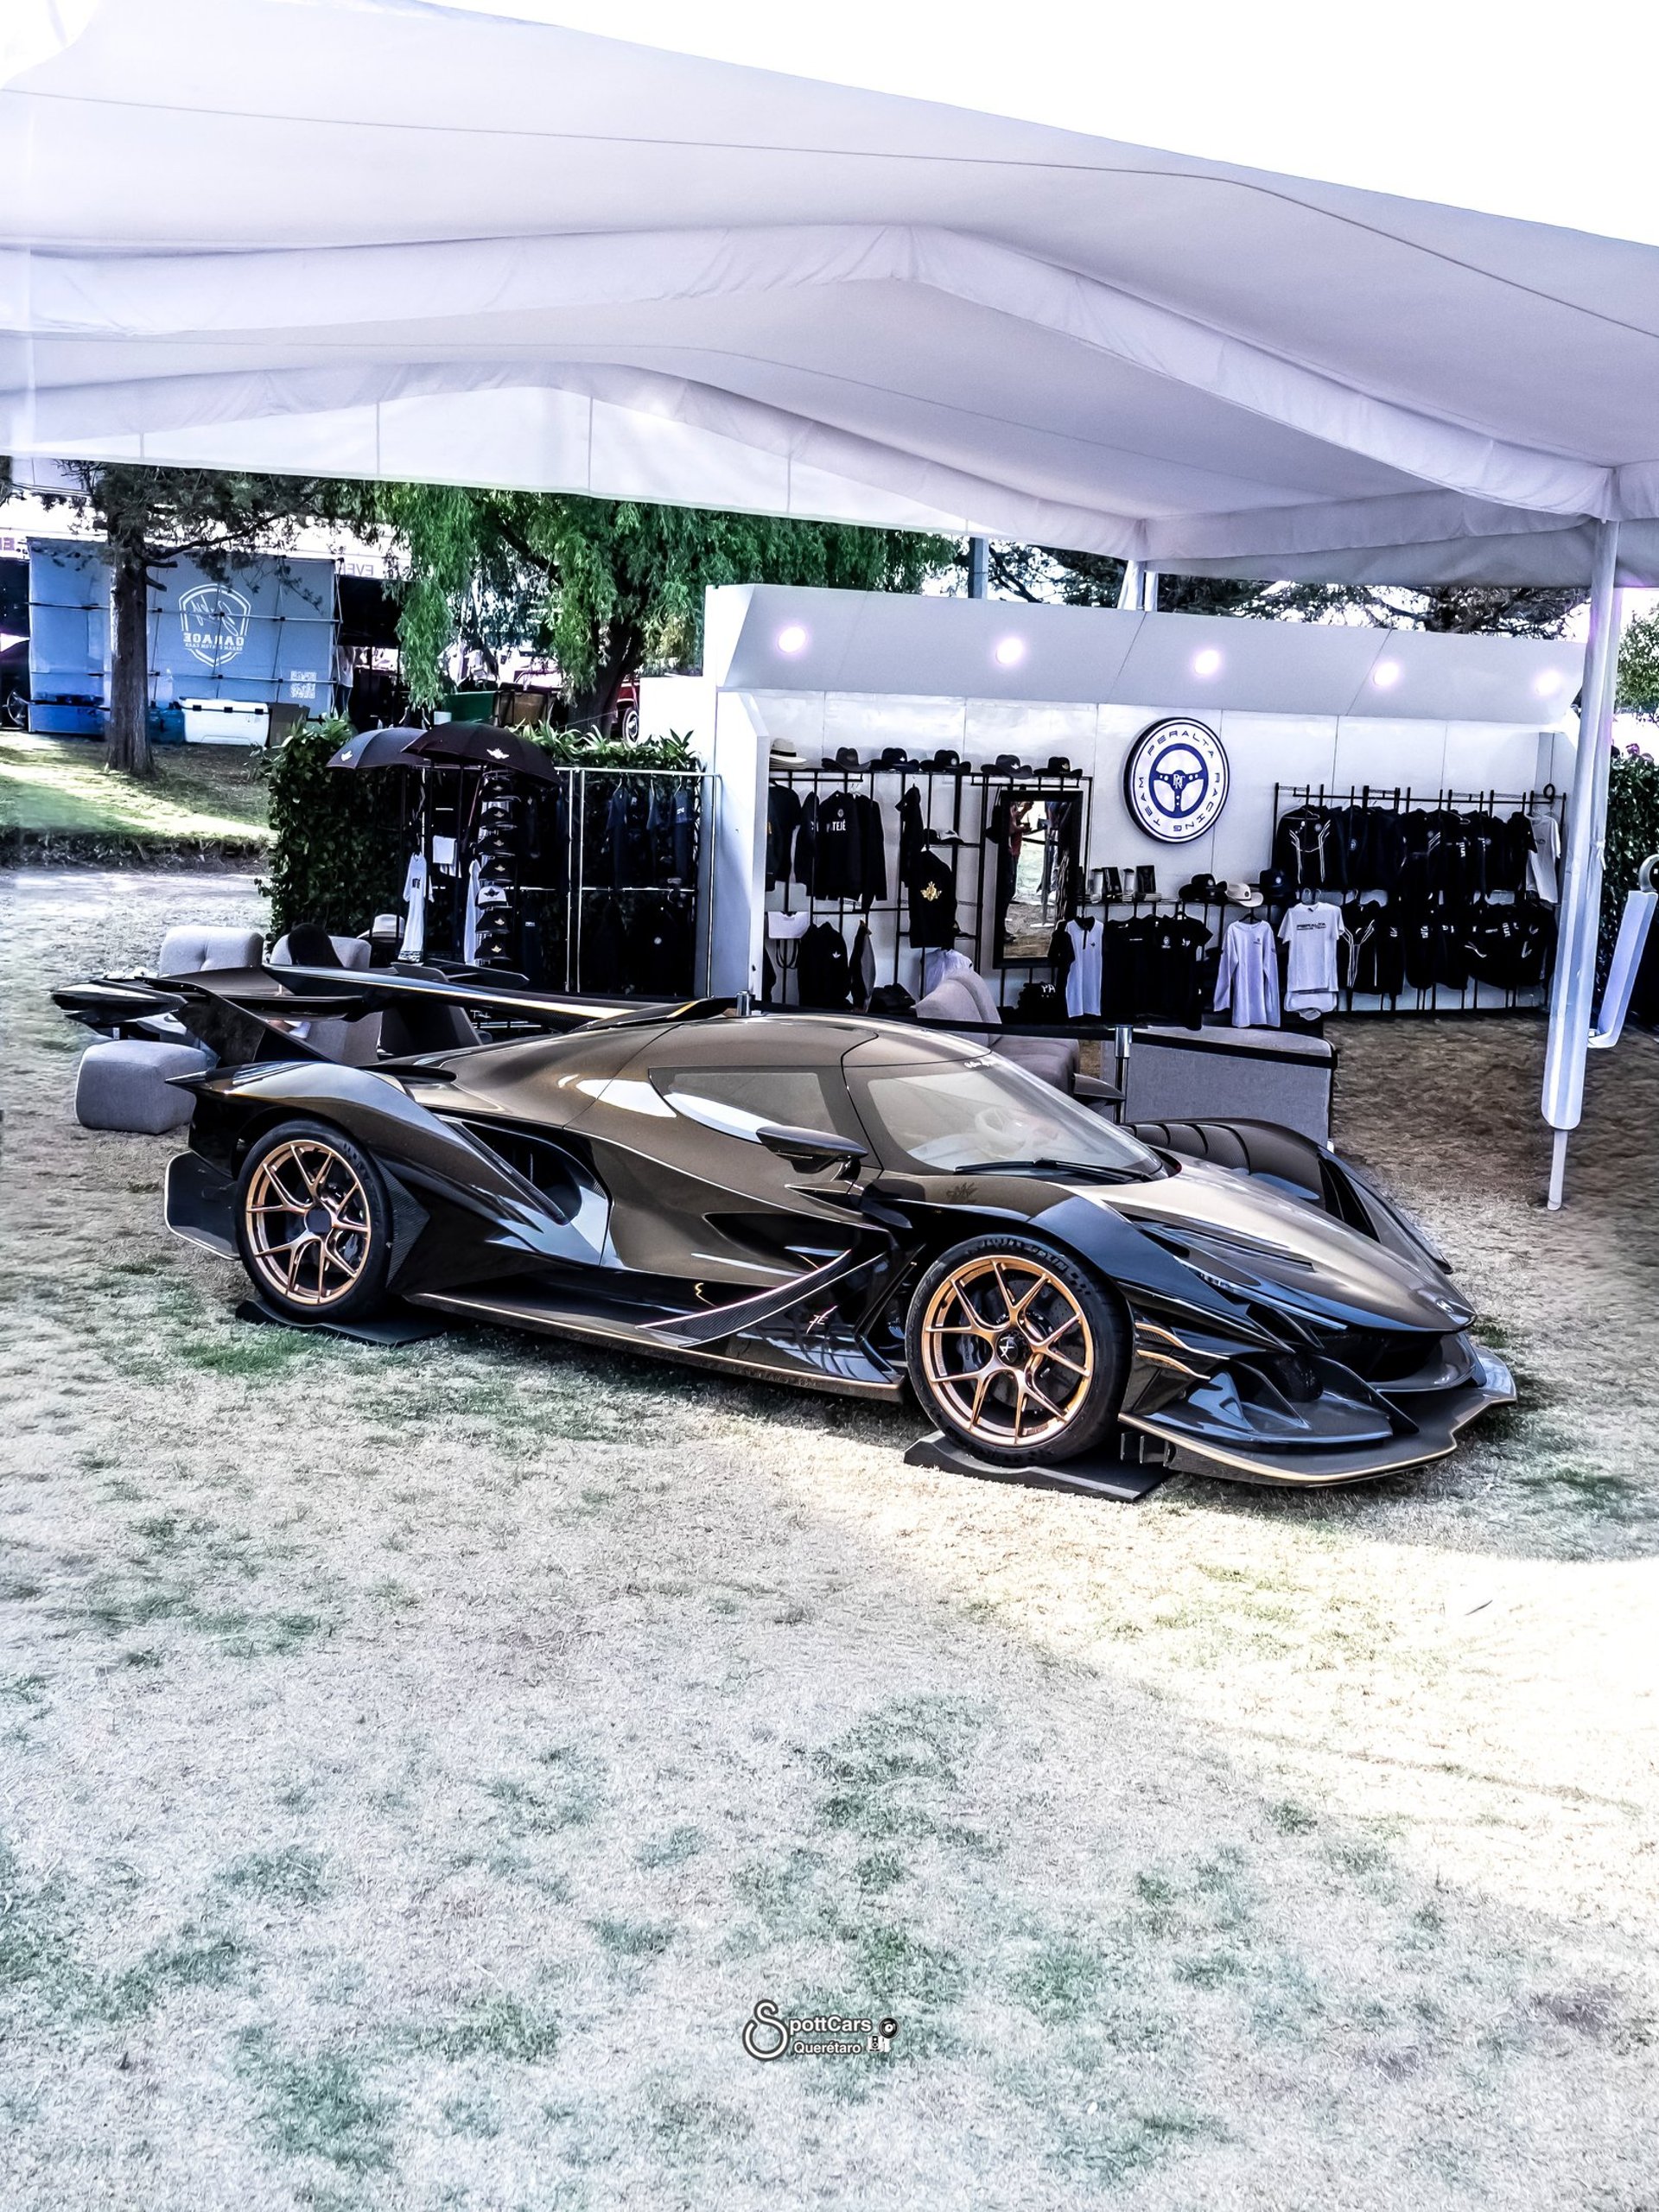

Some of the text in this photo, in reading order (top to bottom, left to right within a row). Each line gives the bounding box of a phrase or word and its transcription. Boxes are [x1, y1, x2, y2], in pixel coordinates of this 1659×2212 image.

[1147, 729, 1215, 759] PERALTA
[1138, 776, 1162, 827] TEAM
[1173, 772, 1221, 833] RACING
